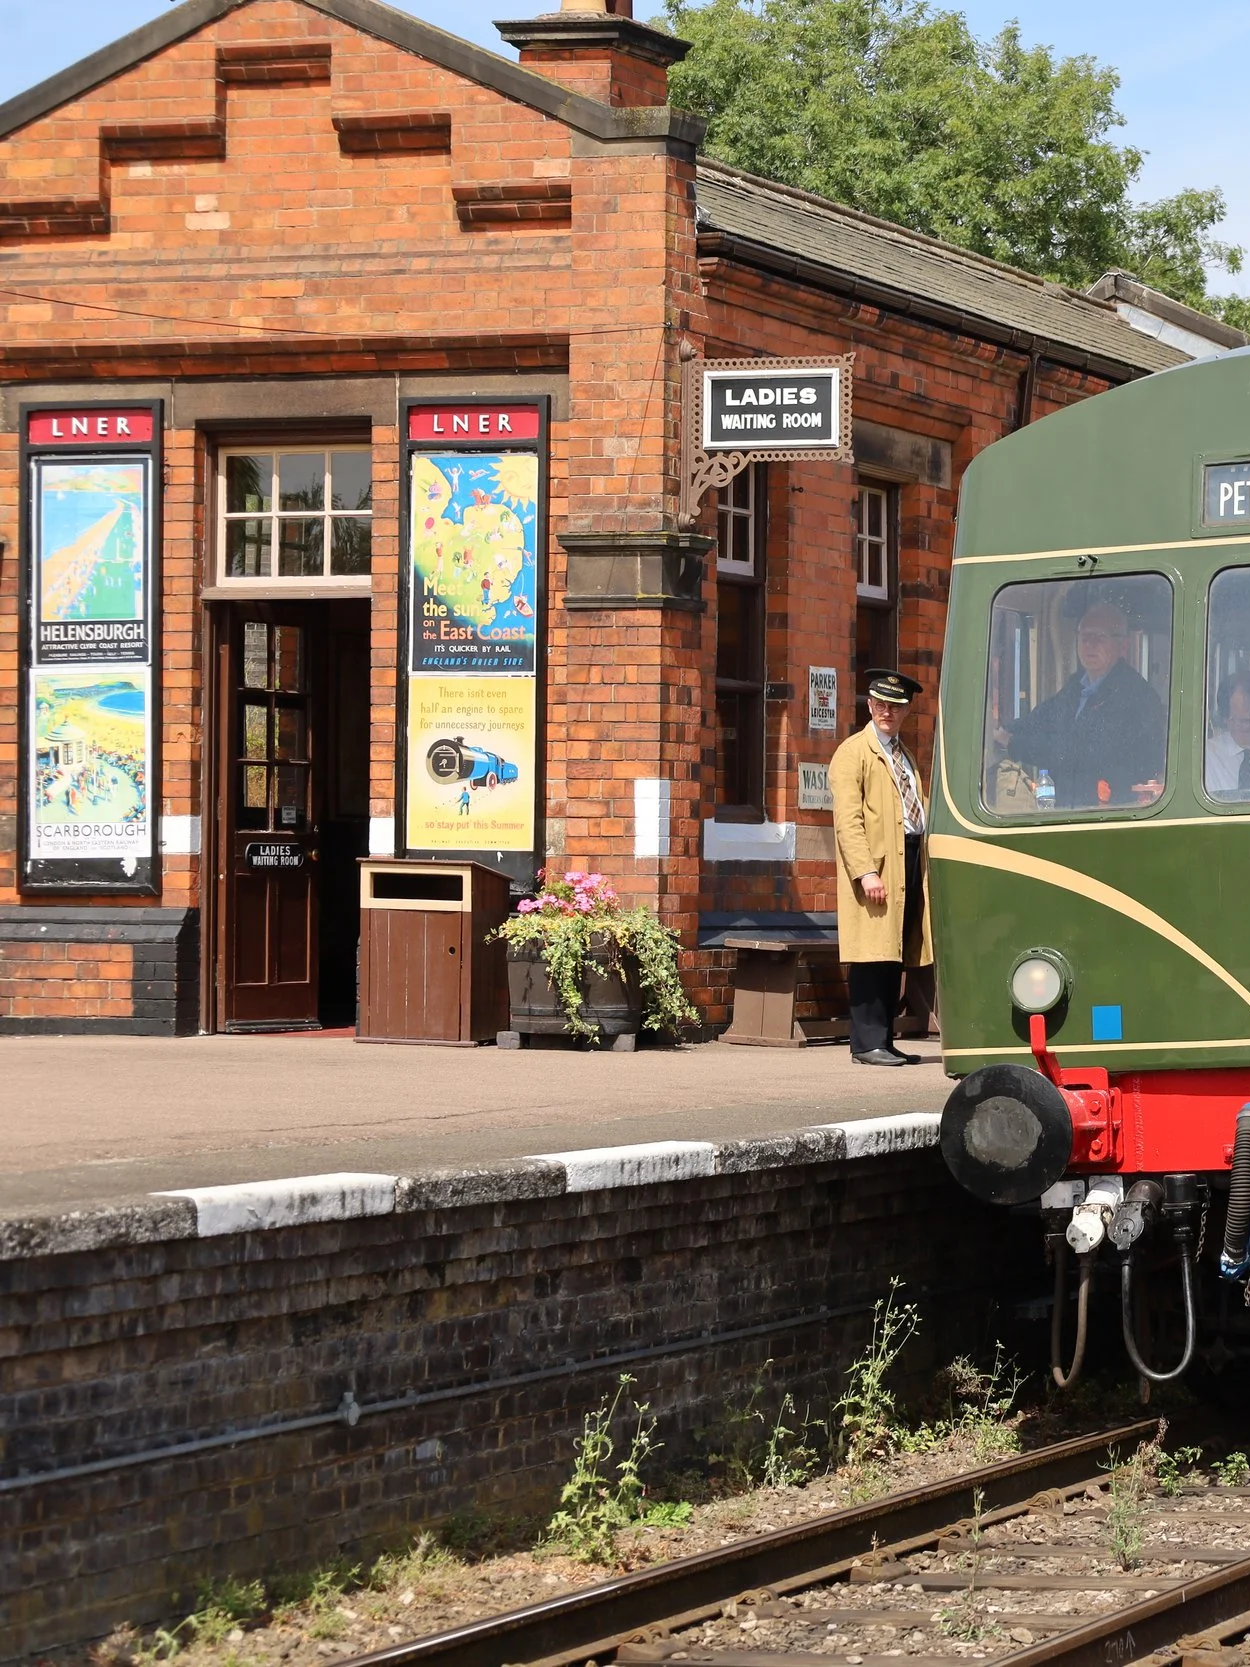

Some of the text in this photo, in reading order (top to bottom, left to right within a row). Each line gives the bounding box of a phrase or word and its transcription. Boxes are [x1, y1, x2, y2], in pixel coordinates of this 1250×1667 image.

[725, 387, 817, 406] LADIES
[51, 416, 131, 436] LNER
[433, 413, 512, 433] LNER
[721, 412, 822, 430] WAITING ROOM
[423, 576, 463, 596] Meet
[423, 598, 482, 617] the sun
[423, 619, 435, 628] on
[423, 620, 526, 641] the East Coast
[41, 624, 144, 641] HELENSBURGH
[120, 641, 144, 649] RESORT
[434, 644, 511, 653] IT'S QUICKER BY RAIL
[503, 657, 524, 666] SIDE
[810, 672, 836, 690] PARKER
[439, 686, 507, 699] There isn't even
[420, 702, 524, 717] half an engine to spare
[811, 707, 835, 719] LEICESTER
[420, 718, 525, 732] for unnecessary journeys
[36, 824, 146, 838] SCARBOROUGH
[425, 821, 435, 829] so
[473, 819, 488, 829] this
[491, 820, 525, 830] Summer
[260, 846, 290, 855] LADIES
[252, 856, 298, 865] WAITING ROOM
